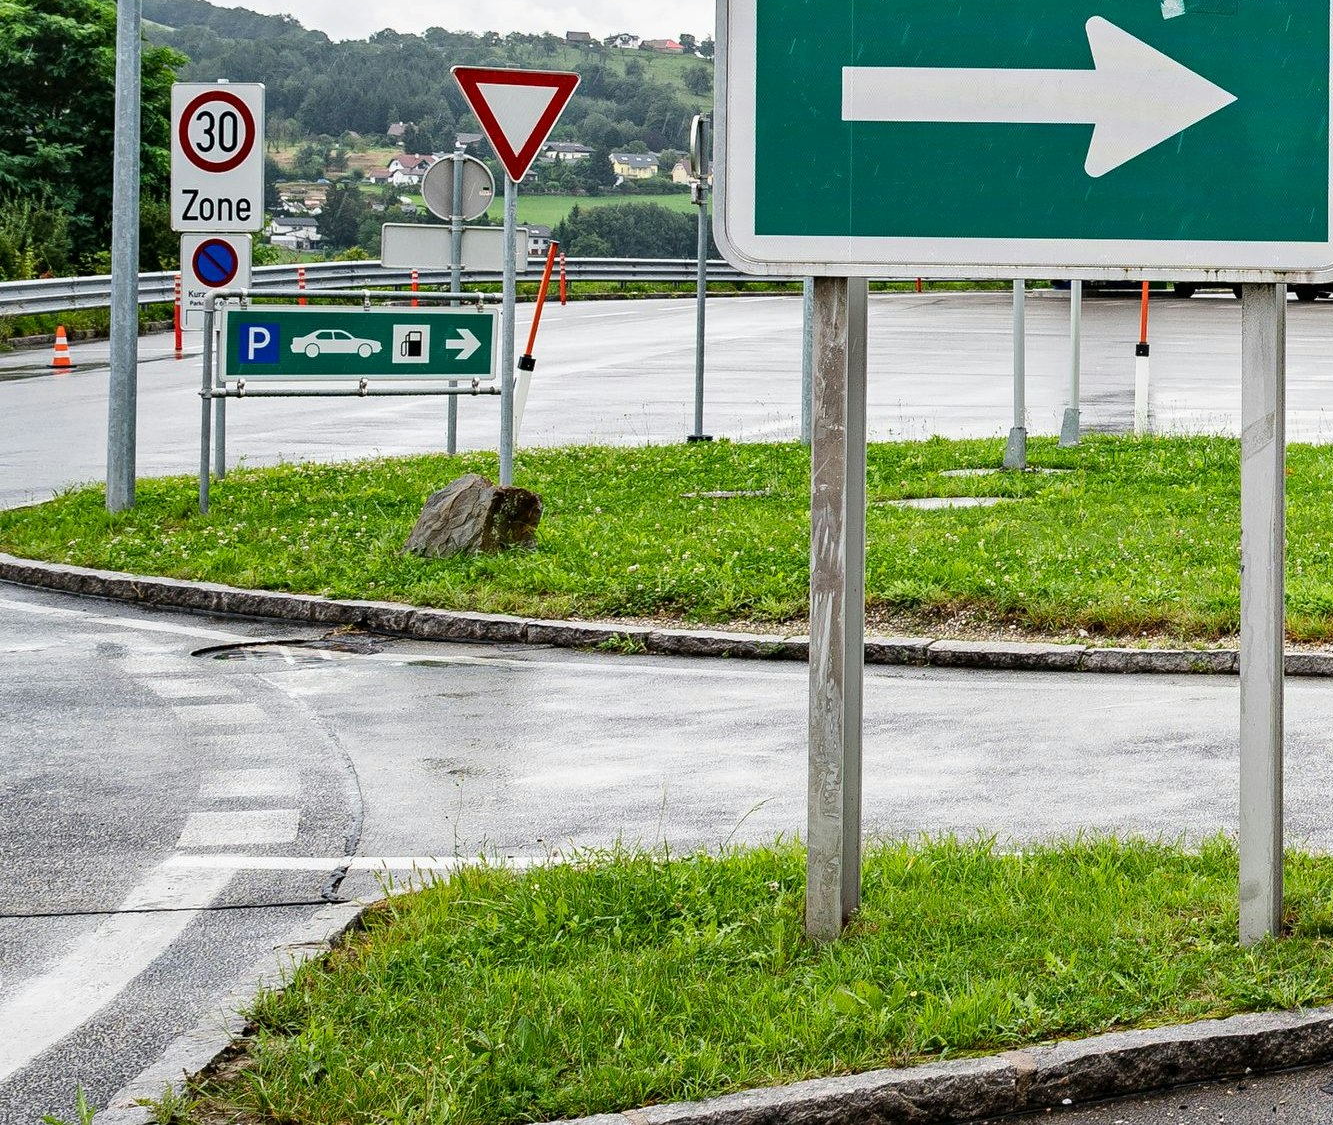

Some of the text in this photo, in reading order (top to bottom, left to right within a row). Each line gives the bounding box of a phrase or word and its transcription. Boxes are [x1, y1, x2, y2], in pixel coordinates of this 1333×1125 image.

[196, 110, 238, 153] 30
[182, 190, 251, 221] Zone
[248, 326, 272, 359] P
